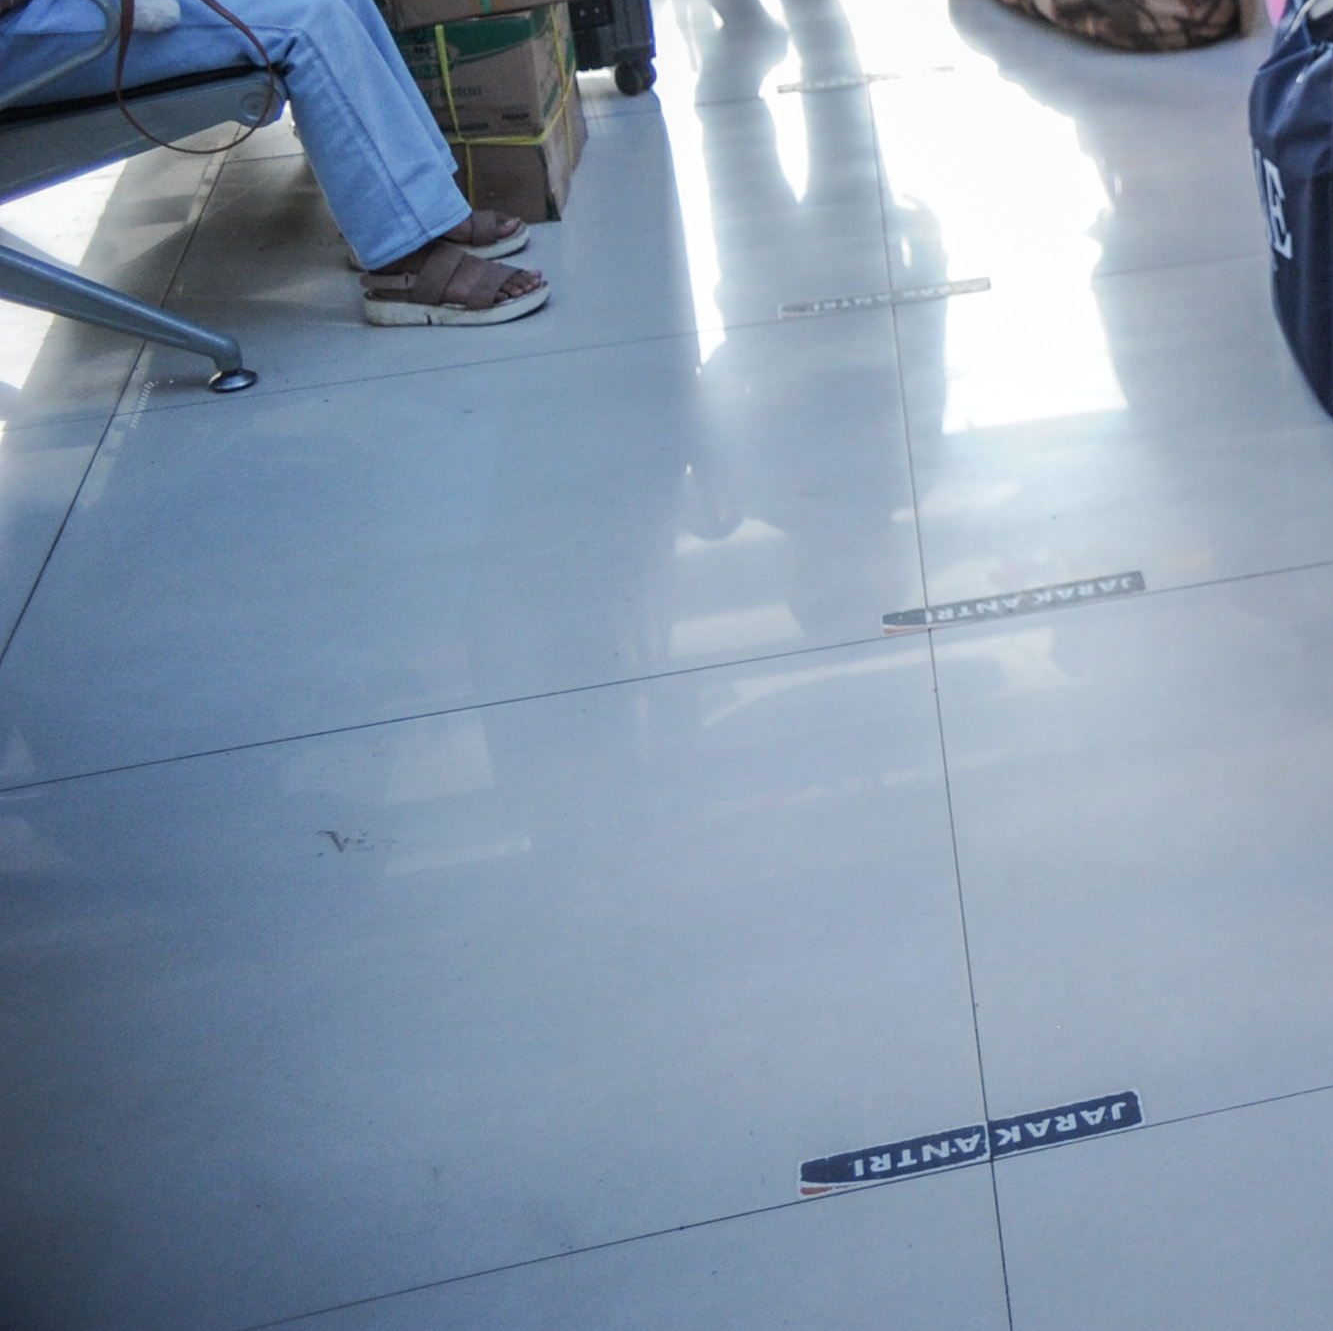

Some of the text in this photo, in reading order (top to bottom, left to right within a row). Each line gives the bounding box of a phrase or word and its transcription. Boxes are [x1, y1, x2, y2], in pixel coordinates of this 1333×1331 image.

[925, 576, 1134, 623] JARAK ANTRI
[854, 1102, 1127, 1177] JARAK ANTRI
